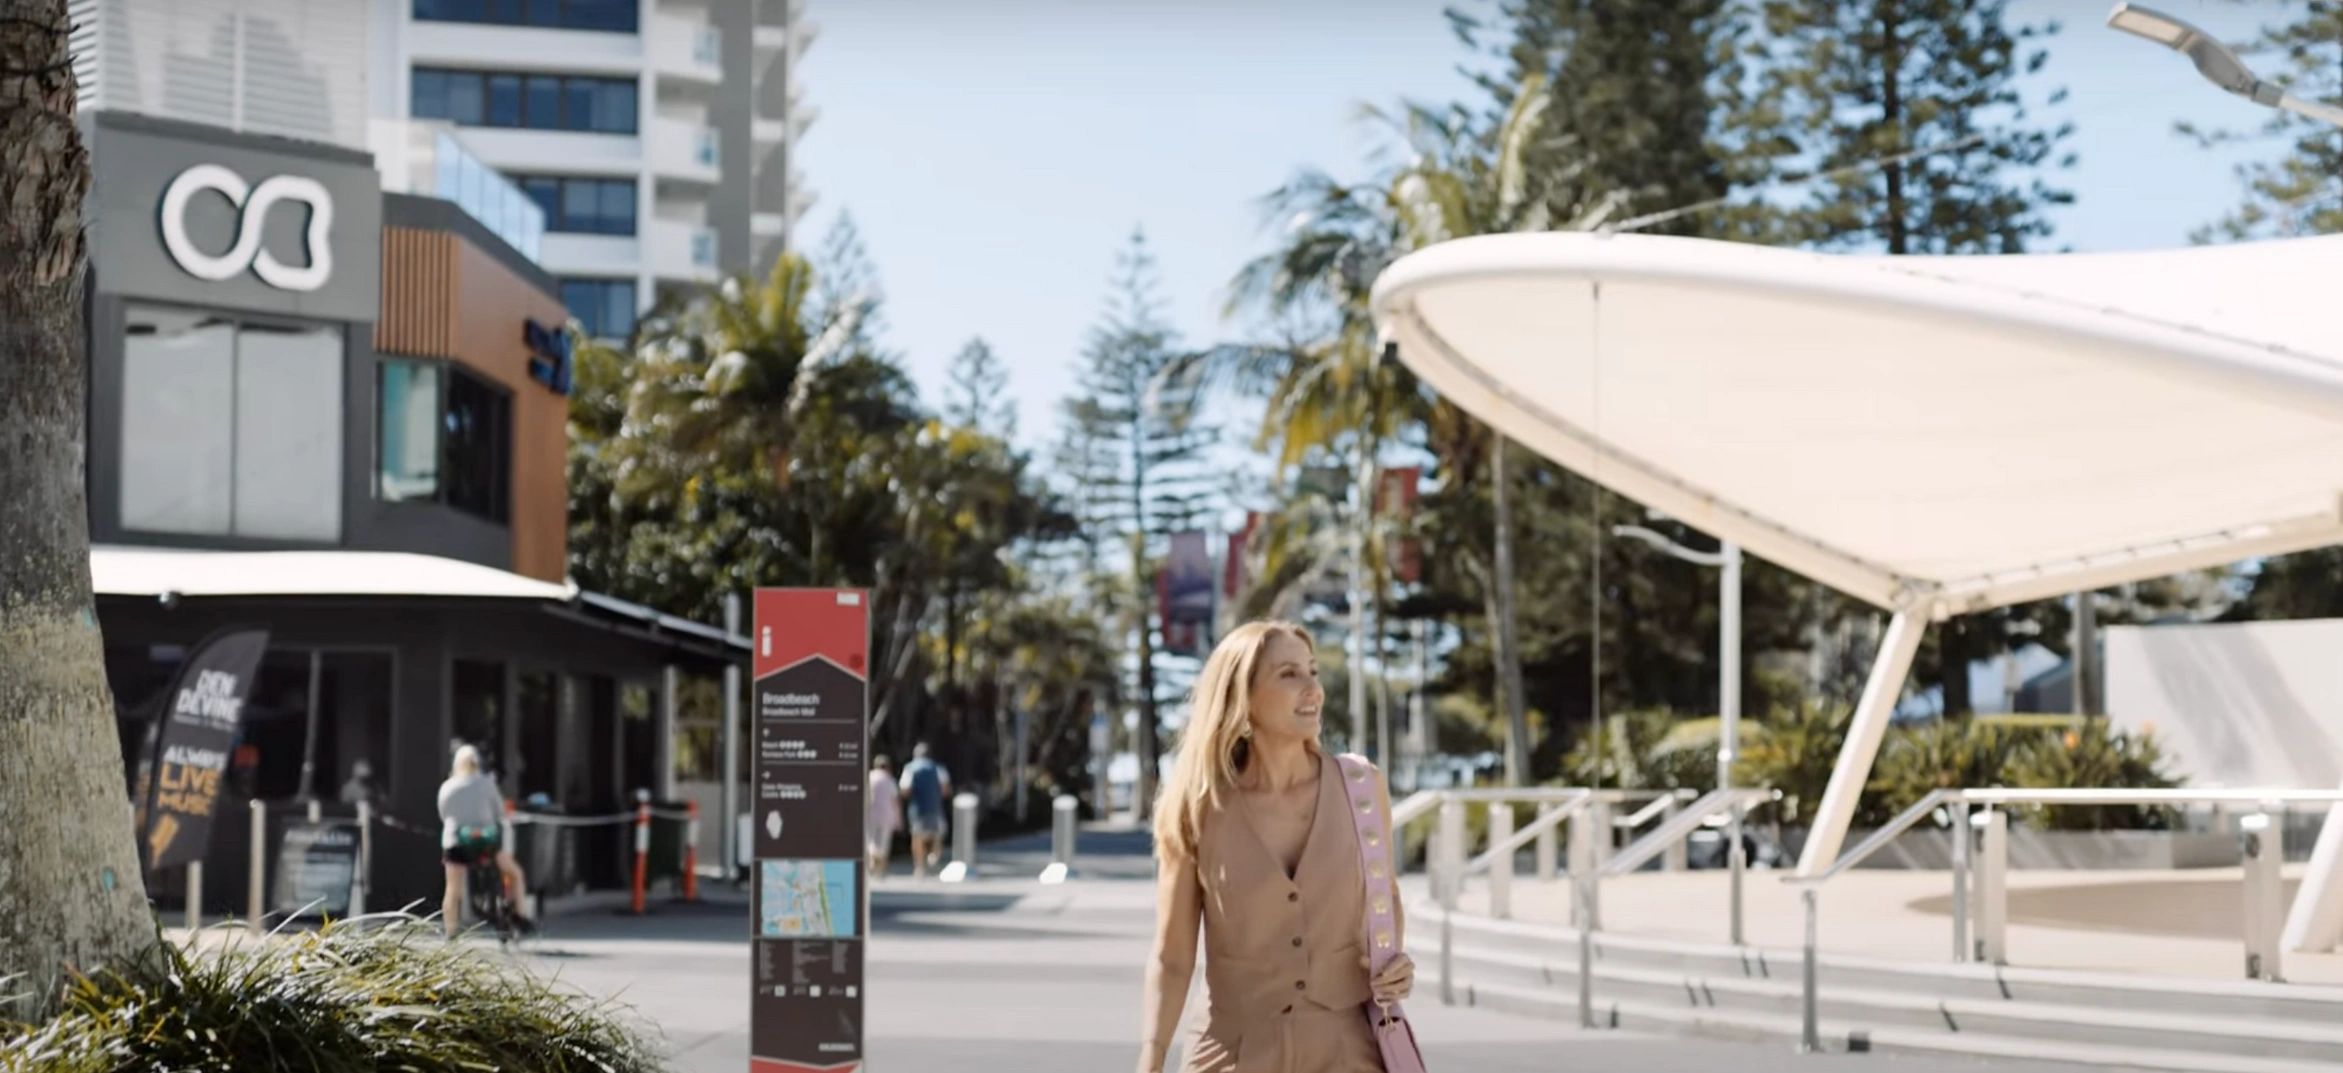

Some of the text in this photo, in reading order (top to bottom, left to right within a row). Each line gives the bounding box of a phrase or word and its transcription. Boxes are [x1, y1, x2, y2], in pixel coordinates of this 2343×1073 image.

[197, 669, 237, 698] DEN
[762, 691, 820, 705] Broadbeach
[176, 688, 242, 723] DEVINE
[160, 762, 220, 797] LIVE
